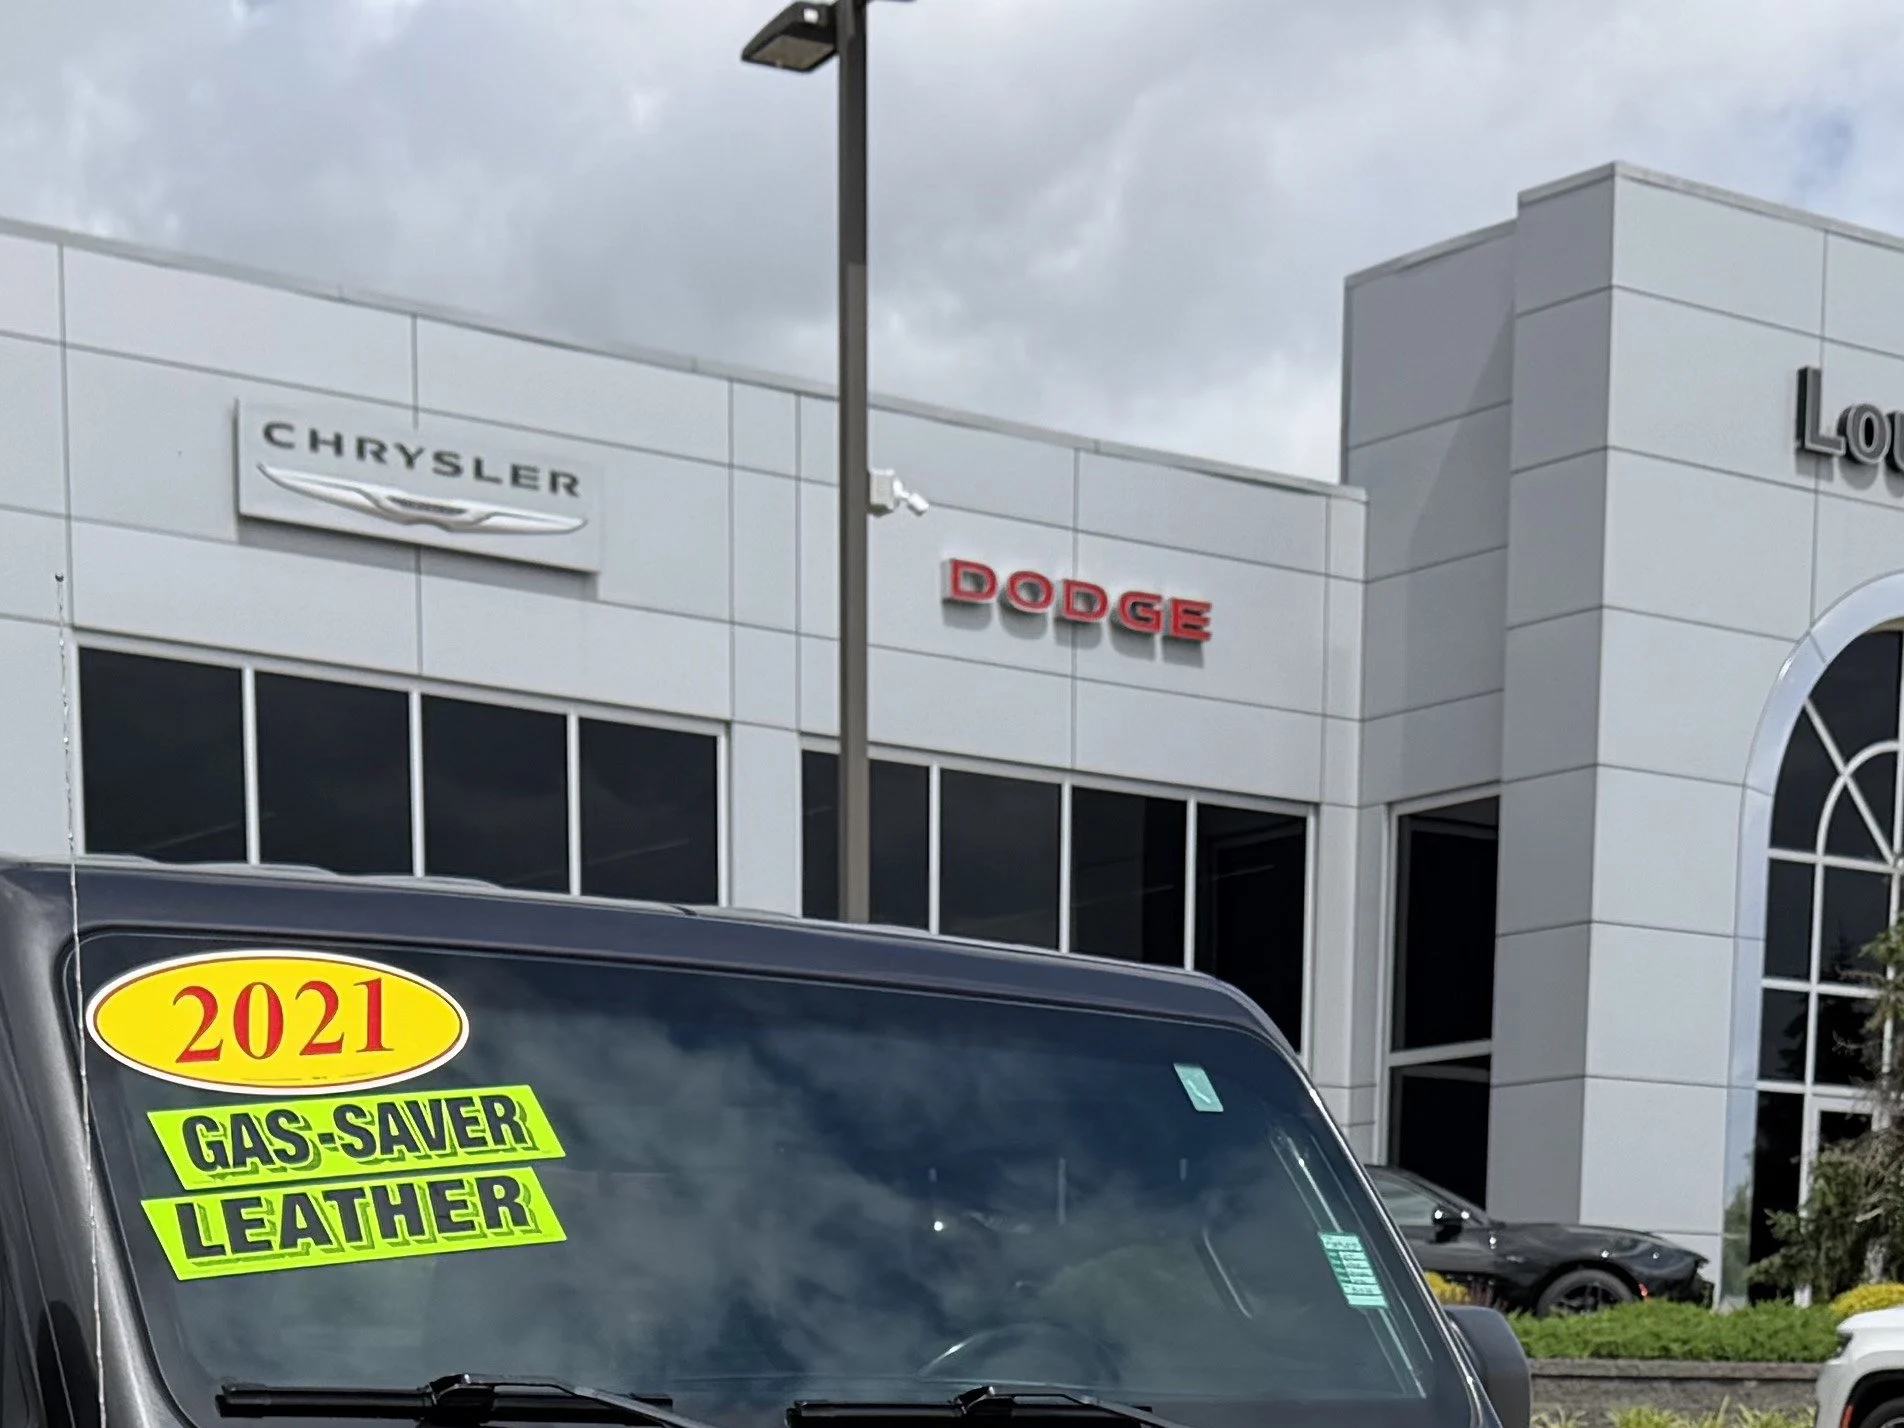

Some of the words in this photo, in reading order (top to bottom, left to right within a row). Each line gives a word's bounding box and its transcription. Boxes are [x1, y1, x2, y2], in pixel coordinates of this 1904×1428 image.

[261, 420, 582, 498] CHRYSLER
[942, 555, 1213, 644] DODGE
[171, 976, 395, 1064] 2021
[181, 1093, 536, 1174] GAS-SAVER
[176, 1174, 542, 1264] LEATHER
